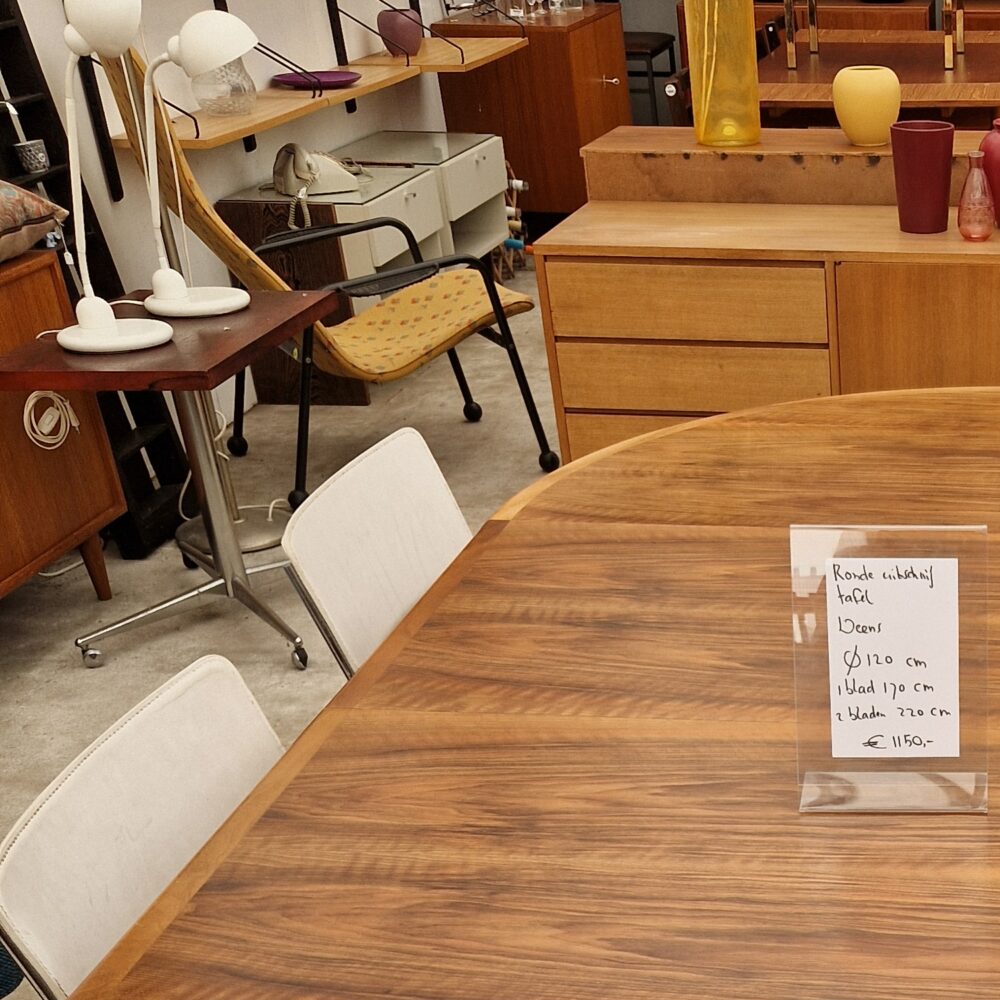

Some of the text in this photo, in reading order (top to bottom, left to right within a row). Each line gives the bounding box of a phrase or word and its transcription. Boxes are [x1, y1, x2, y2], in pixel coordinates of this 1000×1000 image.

[833, 563, 874, 581] Ronde
[837, 584, 874, 605] tafel
[838, 616, 882, 634] Deens
[906, 657, 927, 668] cm
[883, 682, 905, 700] 170
[914, 683, 934, 692] cm
[897, 707, 924, 717] 220
[931, 707, 951, 717] cm
